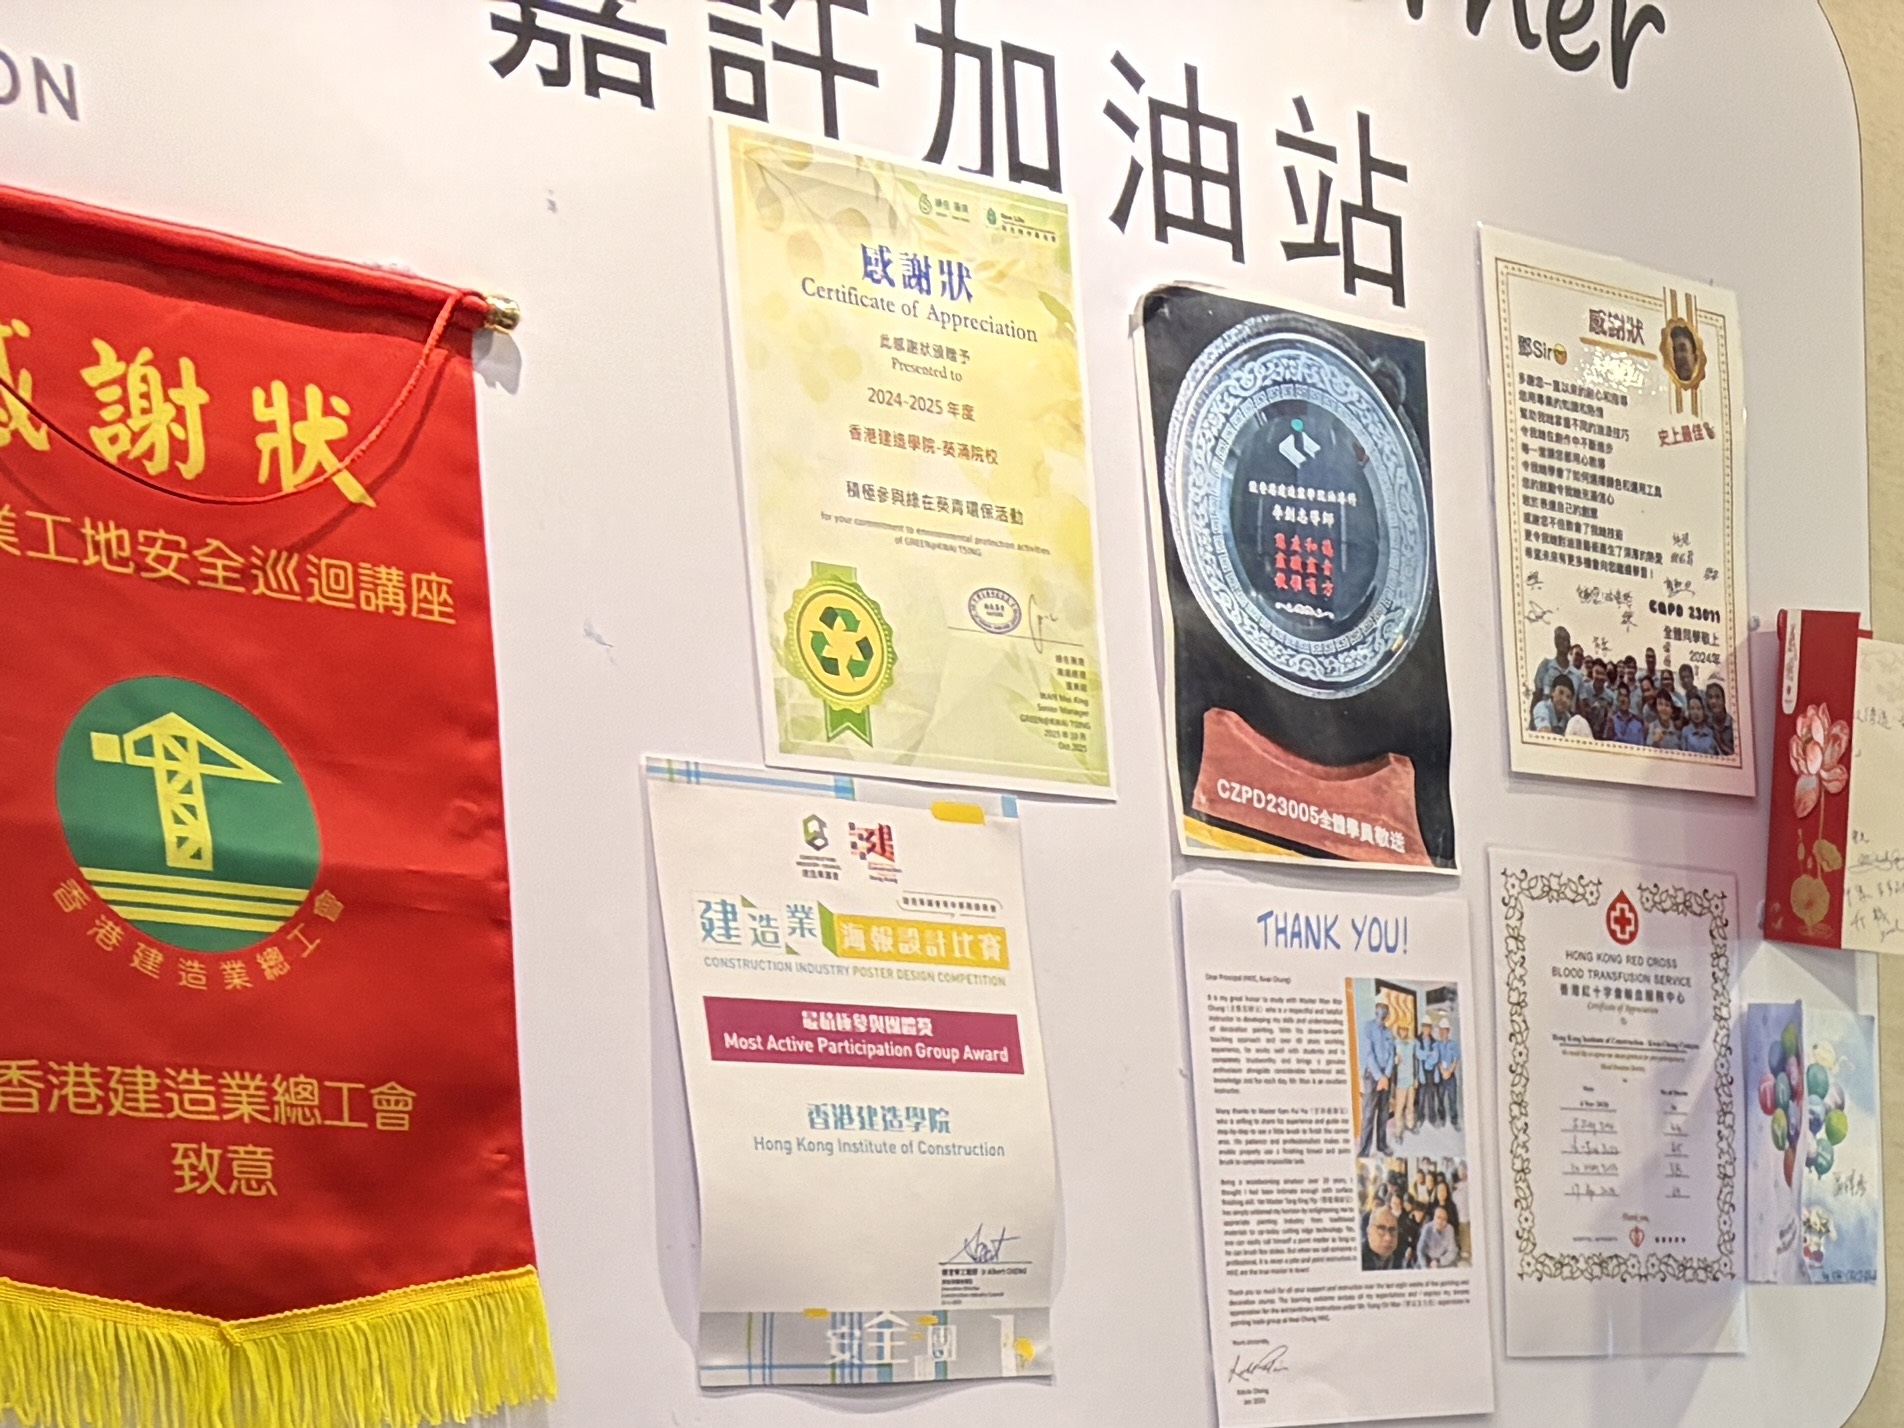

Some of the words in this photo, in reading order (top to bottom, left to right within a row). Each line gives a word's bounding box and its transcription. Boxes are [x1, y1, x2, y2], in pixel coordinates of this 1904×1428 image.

[861, 243, 973, 303] 感謝狀
[801, 277, 896, 313] Certificate
[901, 301, 919, 319] of
[927, 304, 1038, 342] Appreciation
[891, 357, 949, 380] Presented
[951, 370, 963, 382] to
[867, 387, 943, 415] 2024-2025
[946, 400, 976, 422] 年度
[53, 878, 345, 990] 香港建造業總工會
[1257, 910, 1341, 951] THANK
[1351, 914, 1408, 954] YOU!
[704, 956, 793, 973] CONSTRUCTION
[796, 962, 849, 977] INDUSTRY
[852, 966, 894, 980] POSTER
[897, 969, 935, 983] DESIGN
[937, 971, 1006, 987] COMPETITION
[1565, 950, 1593, 962] HONG
[1597, 952, 1622, 965] KONG
[1626, 954, 1644, 966] RED
[1647, 957, 1678, 969] CROSS
[1552, 966, 1584, 979] BLOOD
[1588, 968, 1651, 983] TRANSFUSION
[1654, 974, 1692, 988] SERVICE
[724, 1031, 763, 1051] Most
[766, 1034, 814, 1054] Active
[818, 1037, 912, 1060] Participation
[915, 1042, 960, 1063] Group
[962, 1043, 1009, 1063] Award
[0, 1059, 417, 1131] 香港建造業總工會
[806, 1102, 951, 1134] 香港建造學院
[753, 1136, 792, 1155] Hong
[796, 1136, 834, 1156] Kong
[837, 1138, 896, 1155] Institute
[900, 1138, 914, 1155] of
[917, 1139, 1005, 1157] Construction
[171, 1141, 278, 1197] 致意
